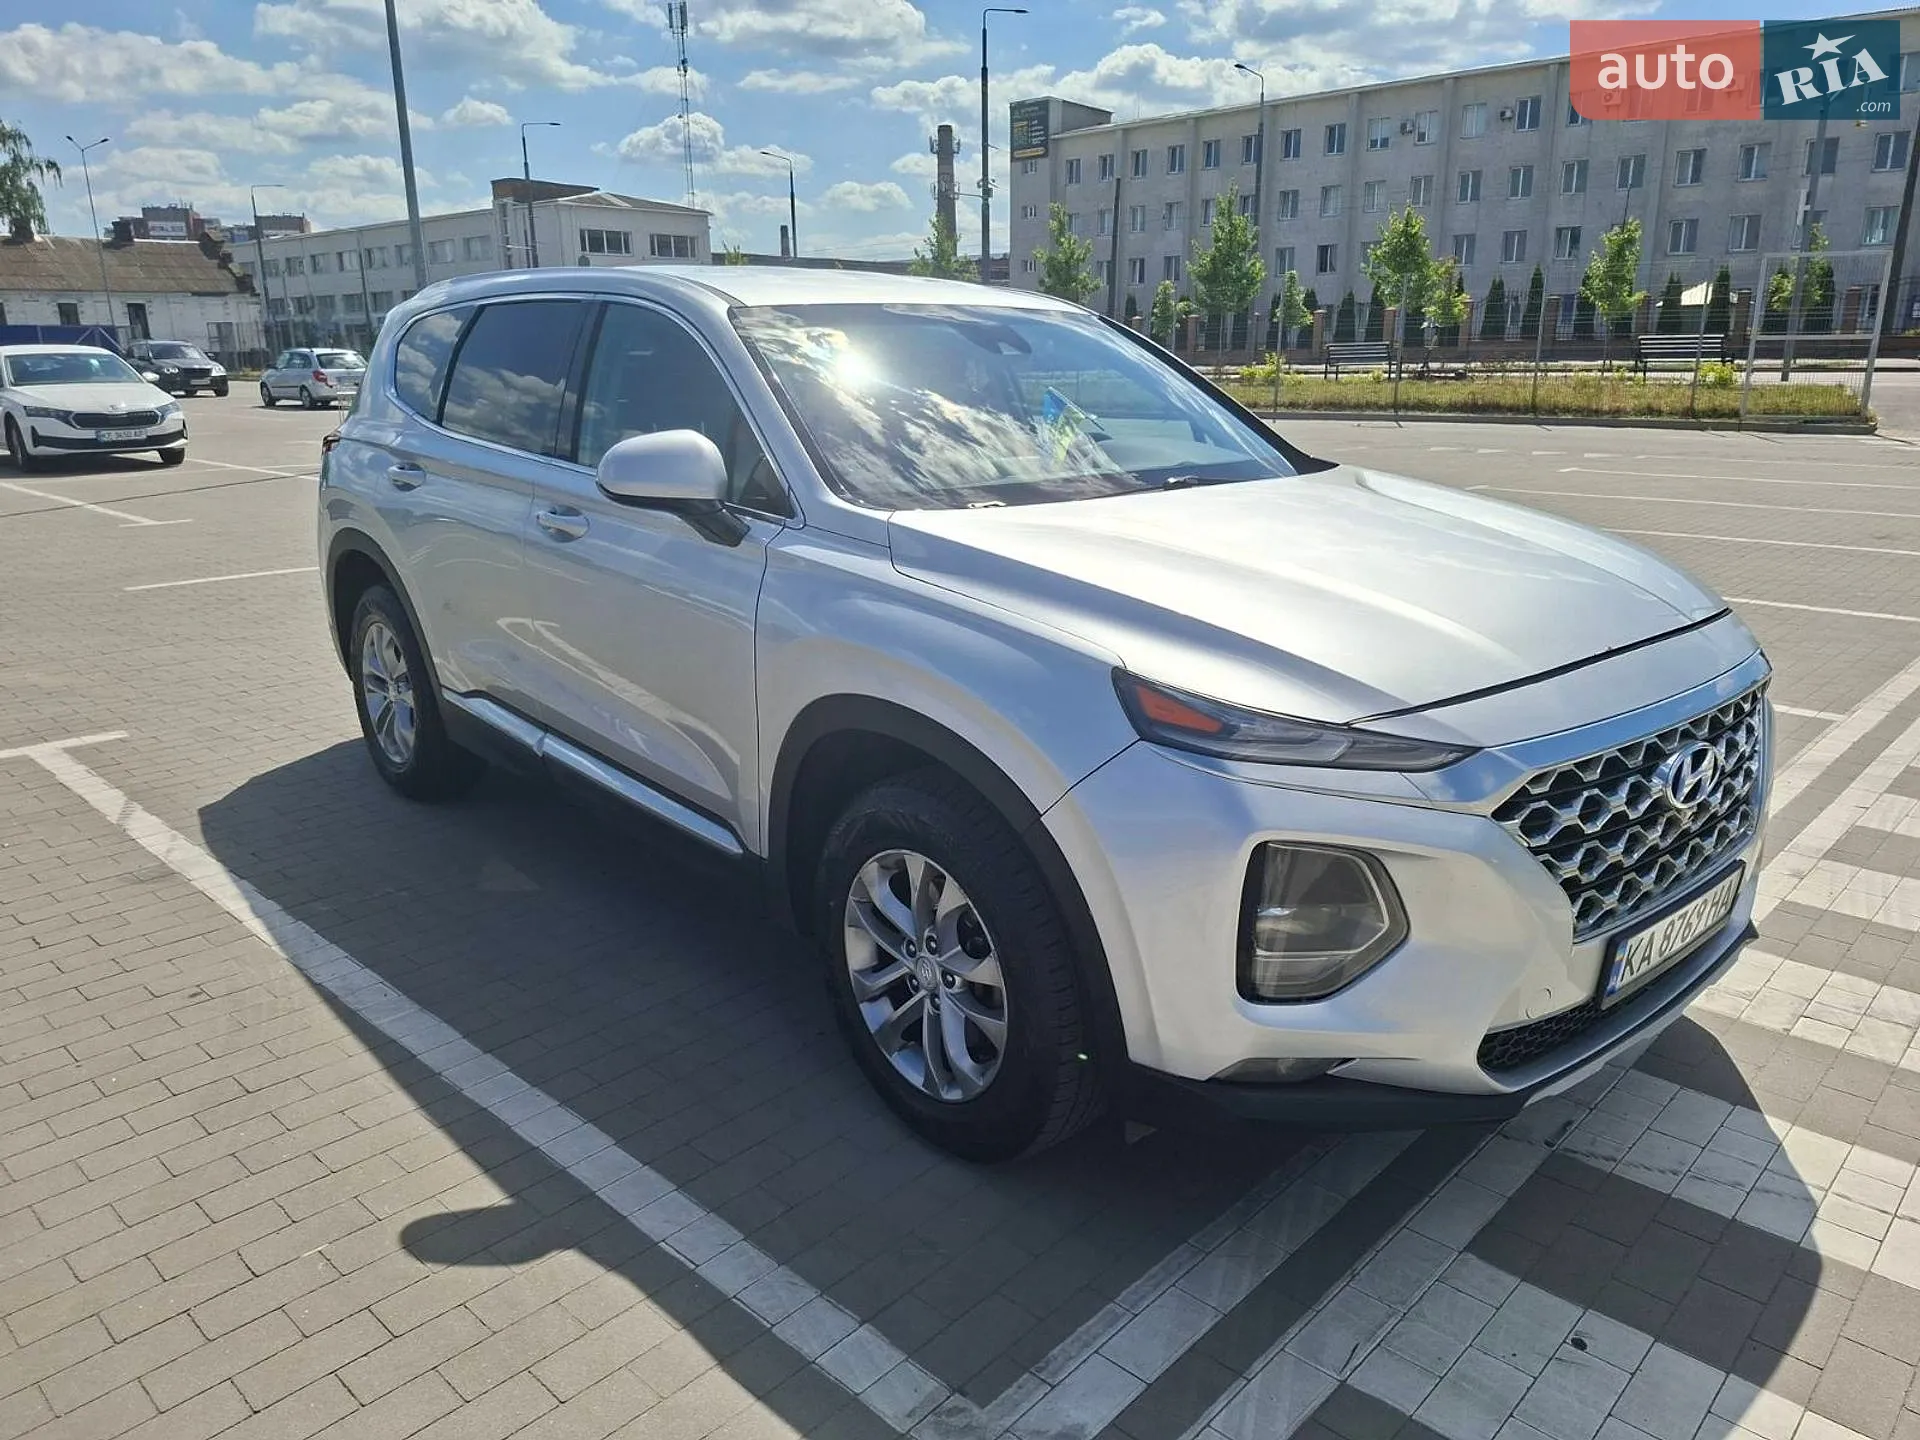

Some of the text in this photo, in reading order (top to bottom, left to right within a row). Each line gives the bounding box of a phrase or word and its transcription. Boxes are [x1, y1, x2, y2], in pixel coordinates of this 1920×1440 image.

[1620, 879, 1734, 982] KA 8769 HA
